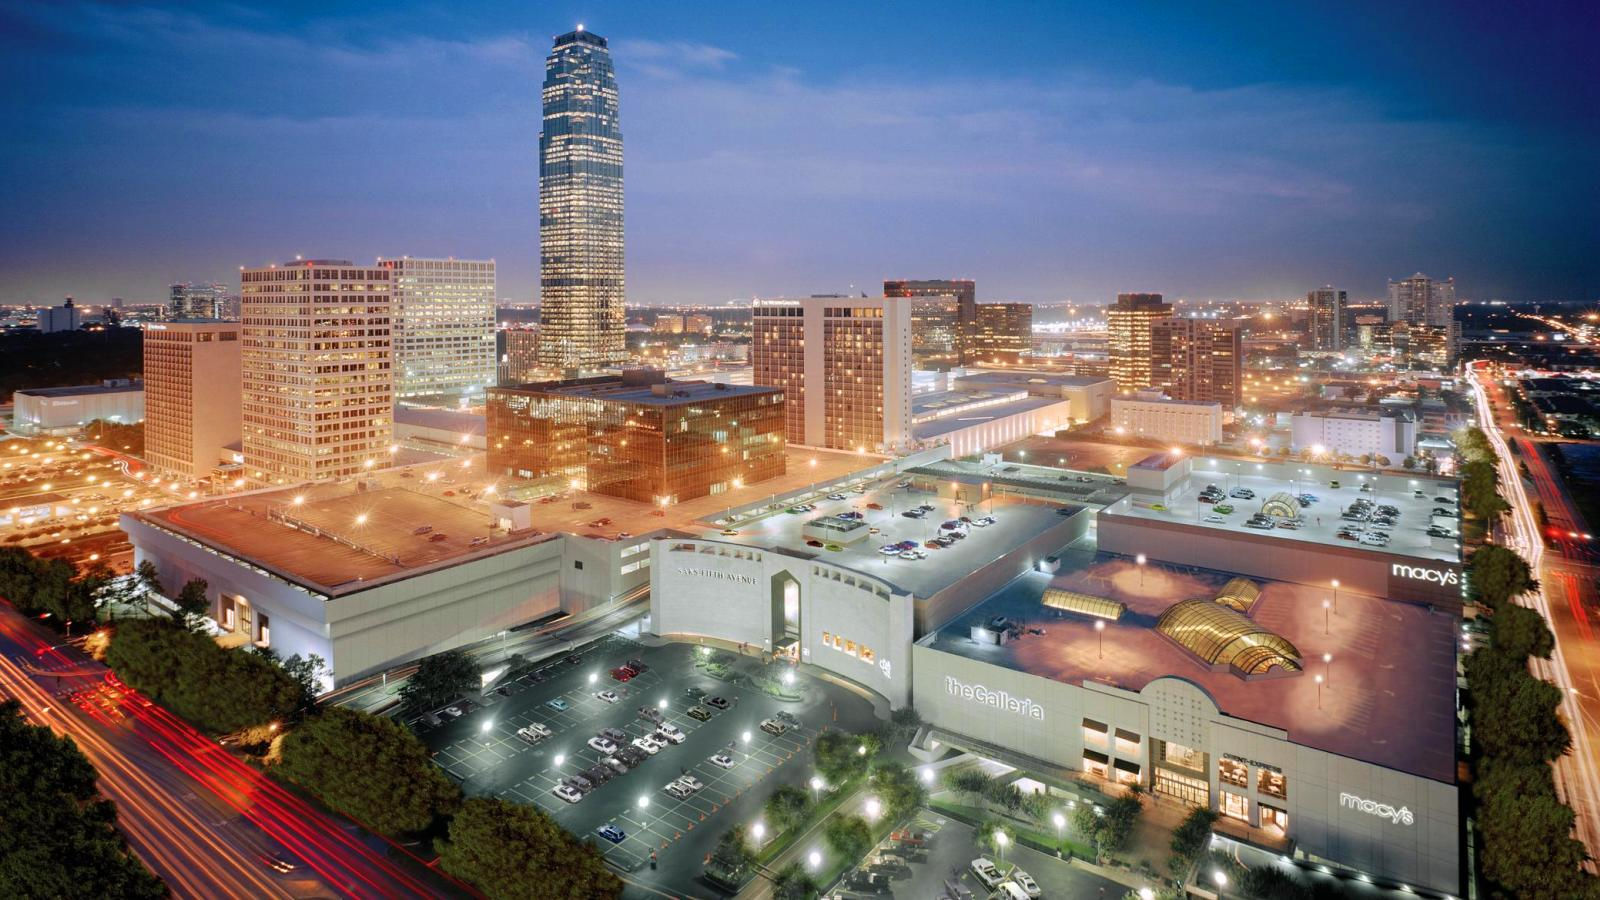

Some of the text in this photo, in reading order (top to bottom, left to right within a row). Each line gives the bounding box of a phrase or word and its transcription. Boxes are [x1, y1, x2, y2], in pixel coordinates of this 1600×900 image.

[677, 567, 758, 585] SAKS FIFTH AVENUE
[1392, 563, 1458, 587] macy's
[1340, 792, 1414, 826] macy's
